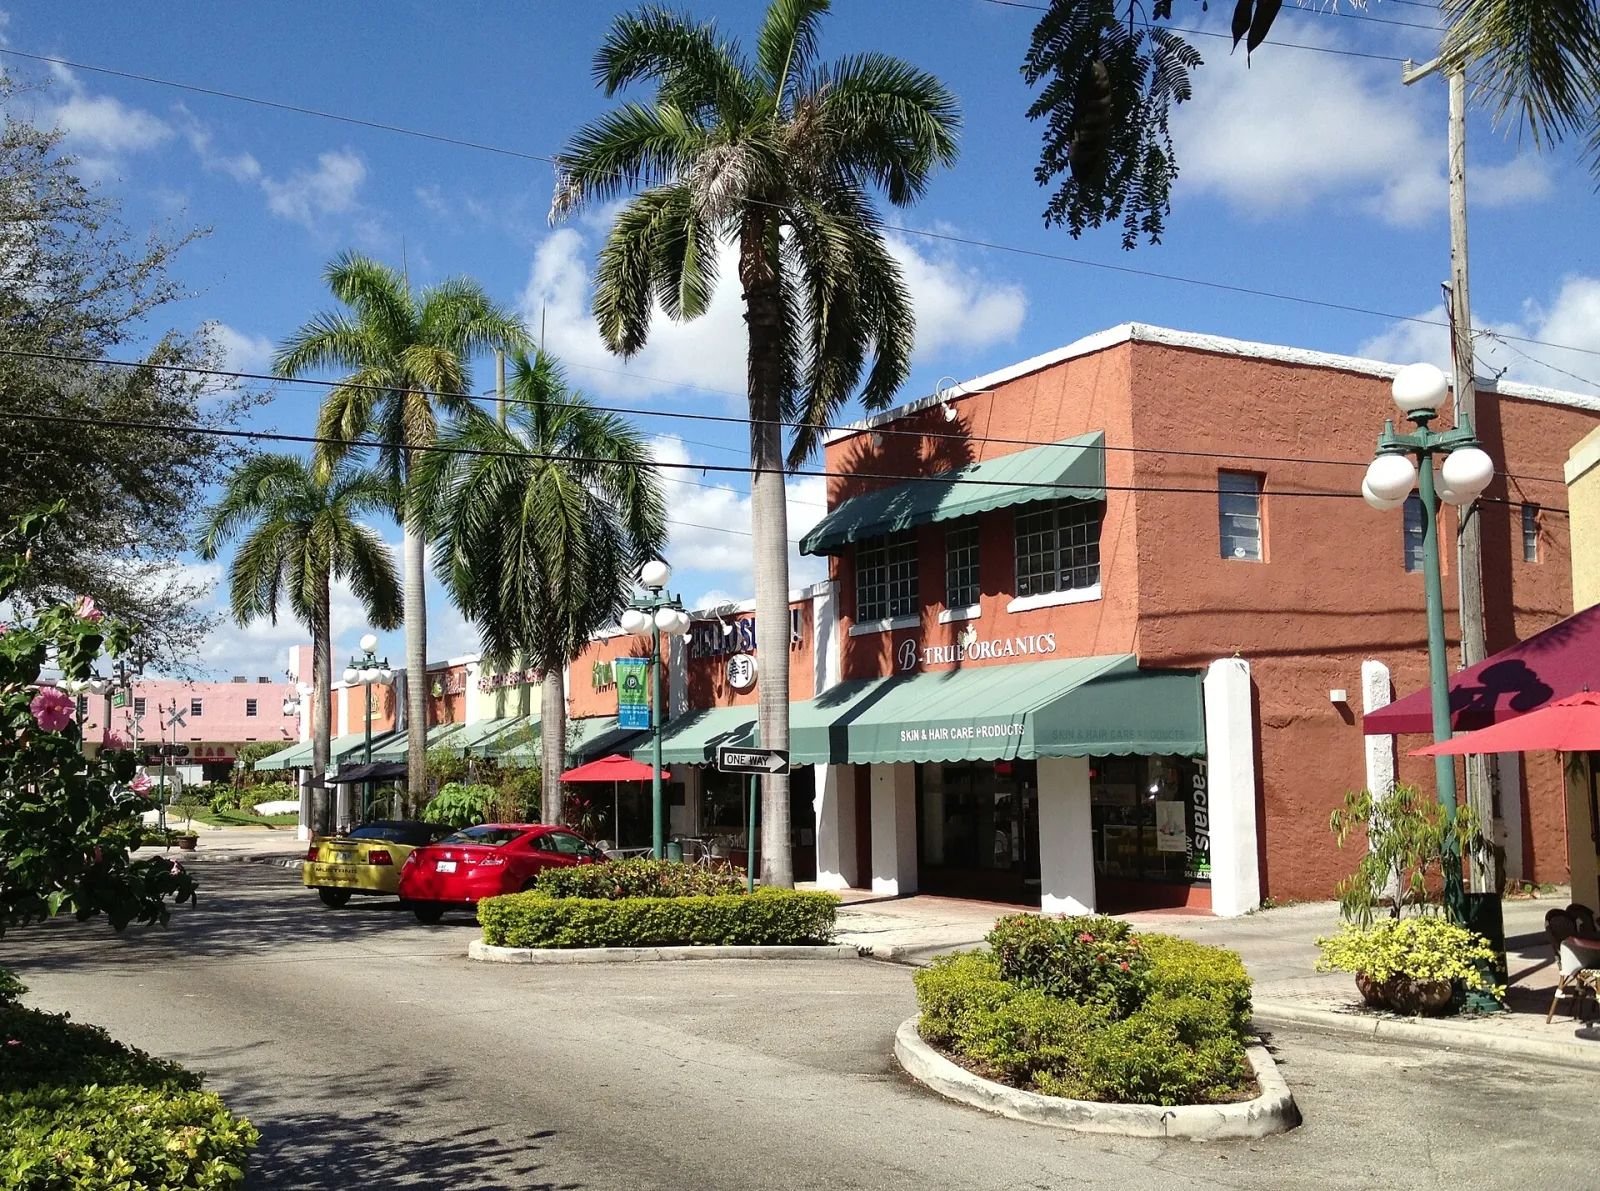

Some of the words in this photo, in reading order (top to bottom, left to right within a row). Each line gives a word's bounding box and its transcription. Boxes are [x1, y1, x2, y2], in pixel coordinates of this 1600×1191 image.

[691, 619, 738, 659] HELLO
[968, 632, 1056, 661] ORGANICS
[900, 730, 919, 742] SKIN
[921, 729, 928, 740] &
[929, 727, 949, 740] HAIR
[950, 727, 974, 739] CARE
[976, 723, 1025, 738] PRODUCTS
[1086, 730, 1107, 739] HAIR
[1110, 730, 1136, 739] CARE
[726, 754, 746, 765] ONE
[749, 755, 769, 766] WAY
[1192, 757, 1210, 851] Facials
